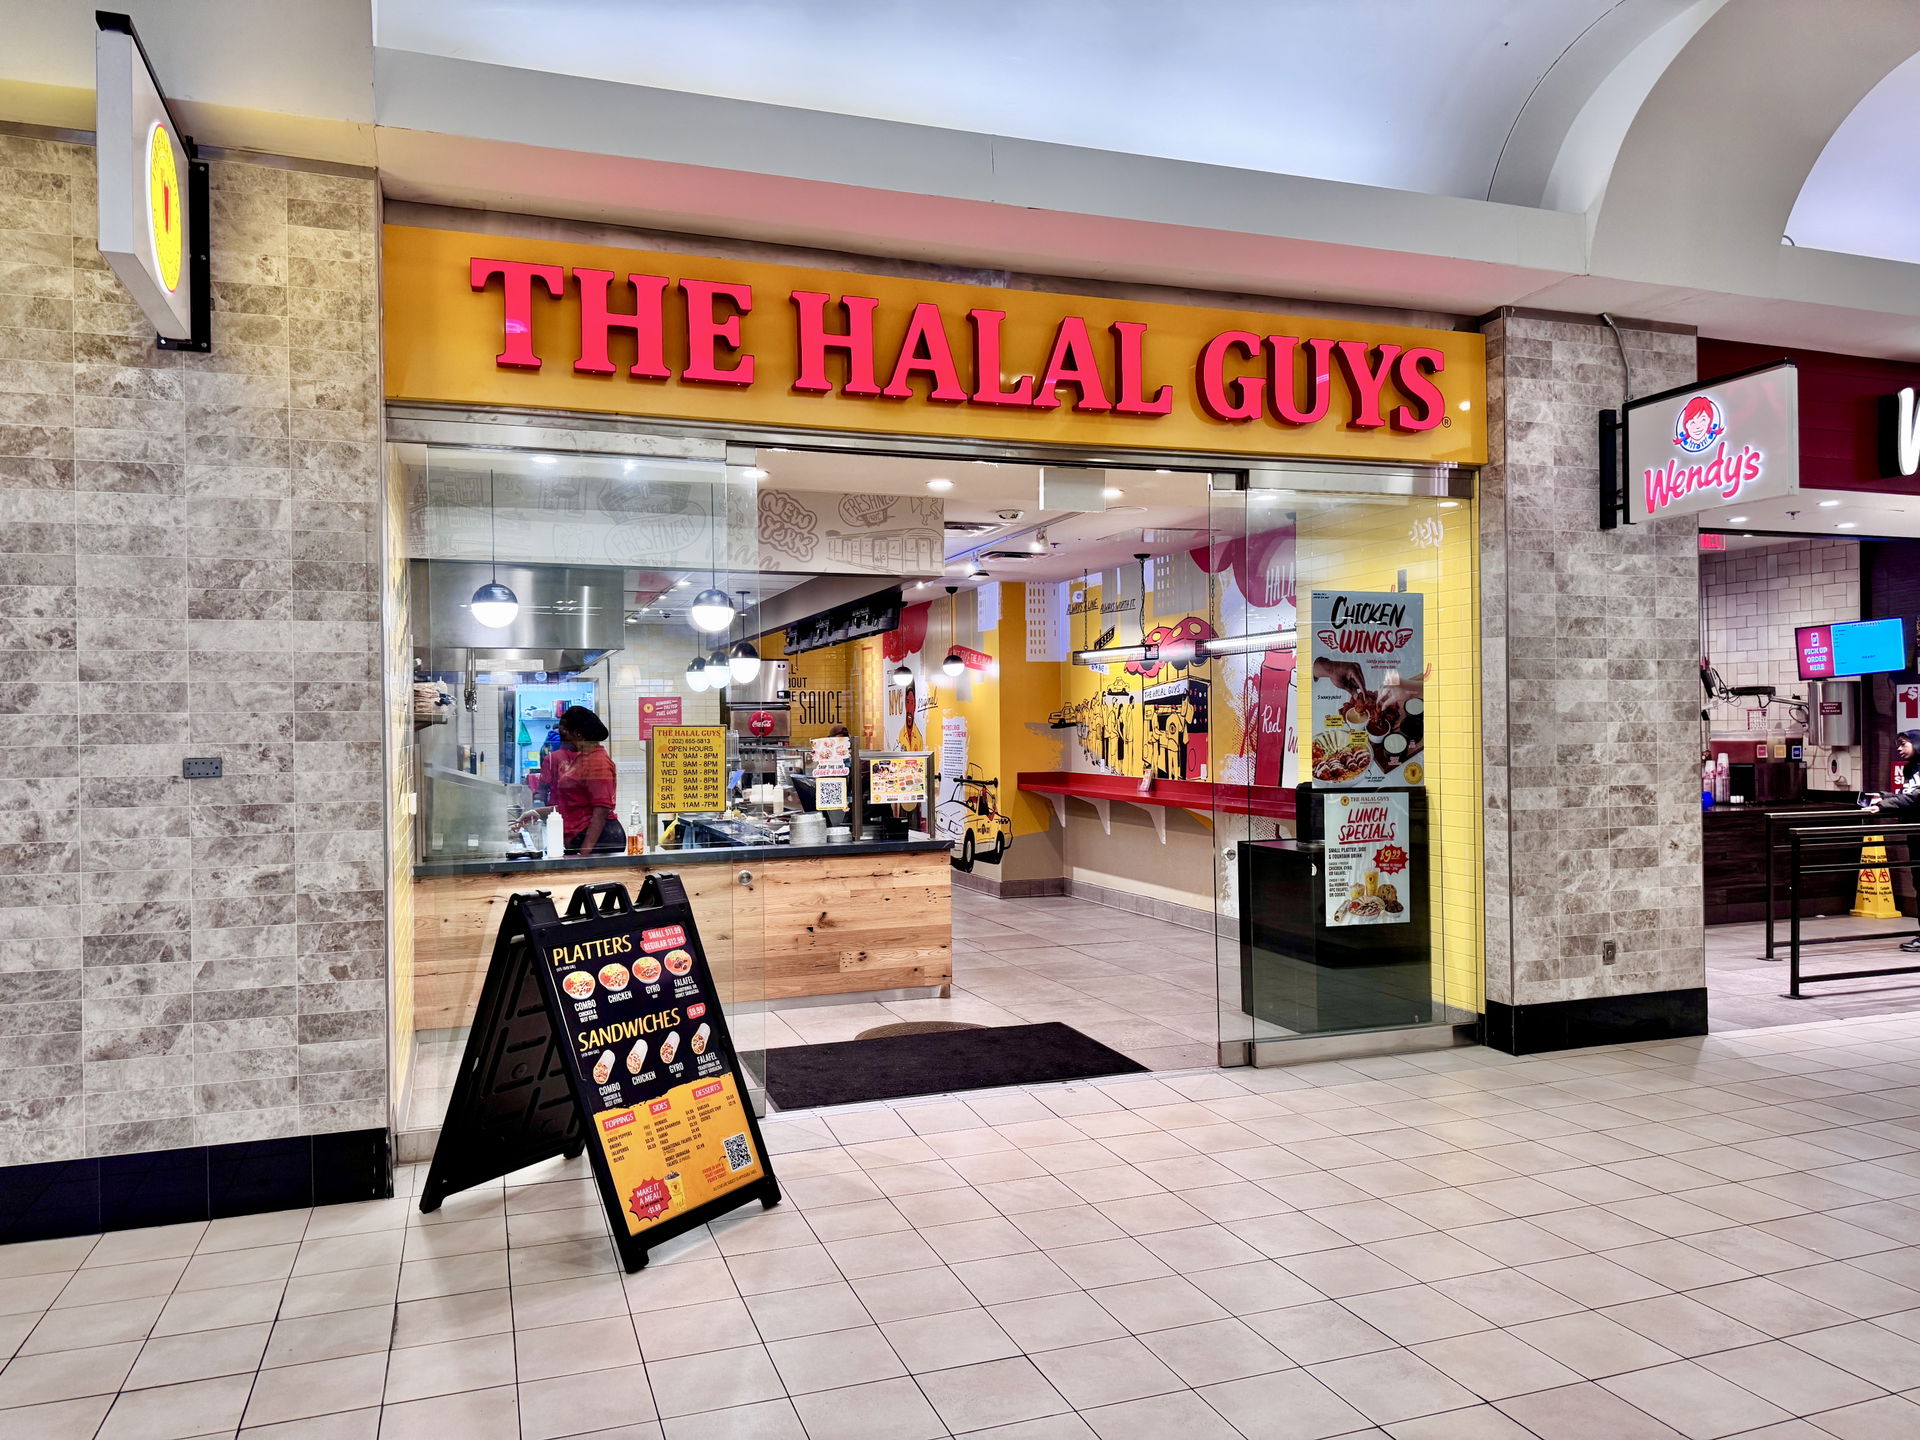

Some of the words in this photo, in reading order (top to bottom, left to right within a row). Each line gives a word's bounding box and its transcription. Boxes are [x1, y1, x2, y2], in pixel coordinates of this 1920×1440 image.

[469, 257, 755, 387] THE
[790, 290, 1173, 415] HALAL
[1198, 330, 1445, 433] GUYS
[1643, 441, 1760, 514] Wendy's
[761, 492, 813, 529] NEW
[761, 515, 814, 555] YORK
[1265, 562, 1296, 605] HALA
[1331, 596, 1406, 629] CHICKEN
[1339, 629, 1395, 654] WINGS
[1144, 690, 1153, 699] THE
[1153, 686, 1168, 697] HALAL
[1168, 683, 1181, 694] GUYS
[800, 691, 842, 724] SAUCE
[888, 689, 904, 716] NYC
[1262, 706, 1281, 733] Red
[1348, 807, 1388, 823] LUNCH
[1338, 822, 1396, 841] SPECIALS
[648, 929, 666, 939] SMALL
[665, 926, 682, 937] $11.99
[552, 934, 632, 967] PLATTERS
[643, 940, 668, 951] REGULAR
[645, 984, 660, 995] GYRO
[674, 976, 694, 987] FALAFEL
[607, 991, 632, 1003] CHICKEN
[574, 1000, 597, 1012] COMBO
[688, 1005, 704, 1016] $9.99
[578, 1008, 681, 1052] SANDWICHES
[696, 1052, 717, 1064] FALAFEL
[668, 1062, 684, 1074] GYRO
[631, 1071, 656, 1085] CHICKEN
[598, 1082, 621, 1096] COMBO
[695, 1083, 720, 1098] DESSERTS
[652, 1100, 668, 1113] SIDES
[604, 1113, 634, 1129] TOPPINGS
[636, 1186, 652, 1198] MAKE
[652, 1182, 660, 1193] IT
[639, 1197, 645, 1206] A
[644, 1191, 662, 1204] MEAL!
